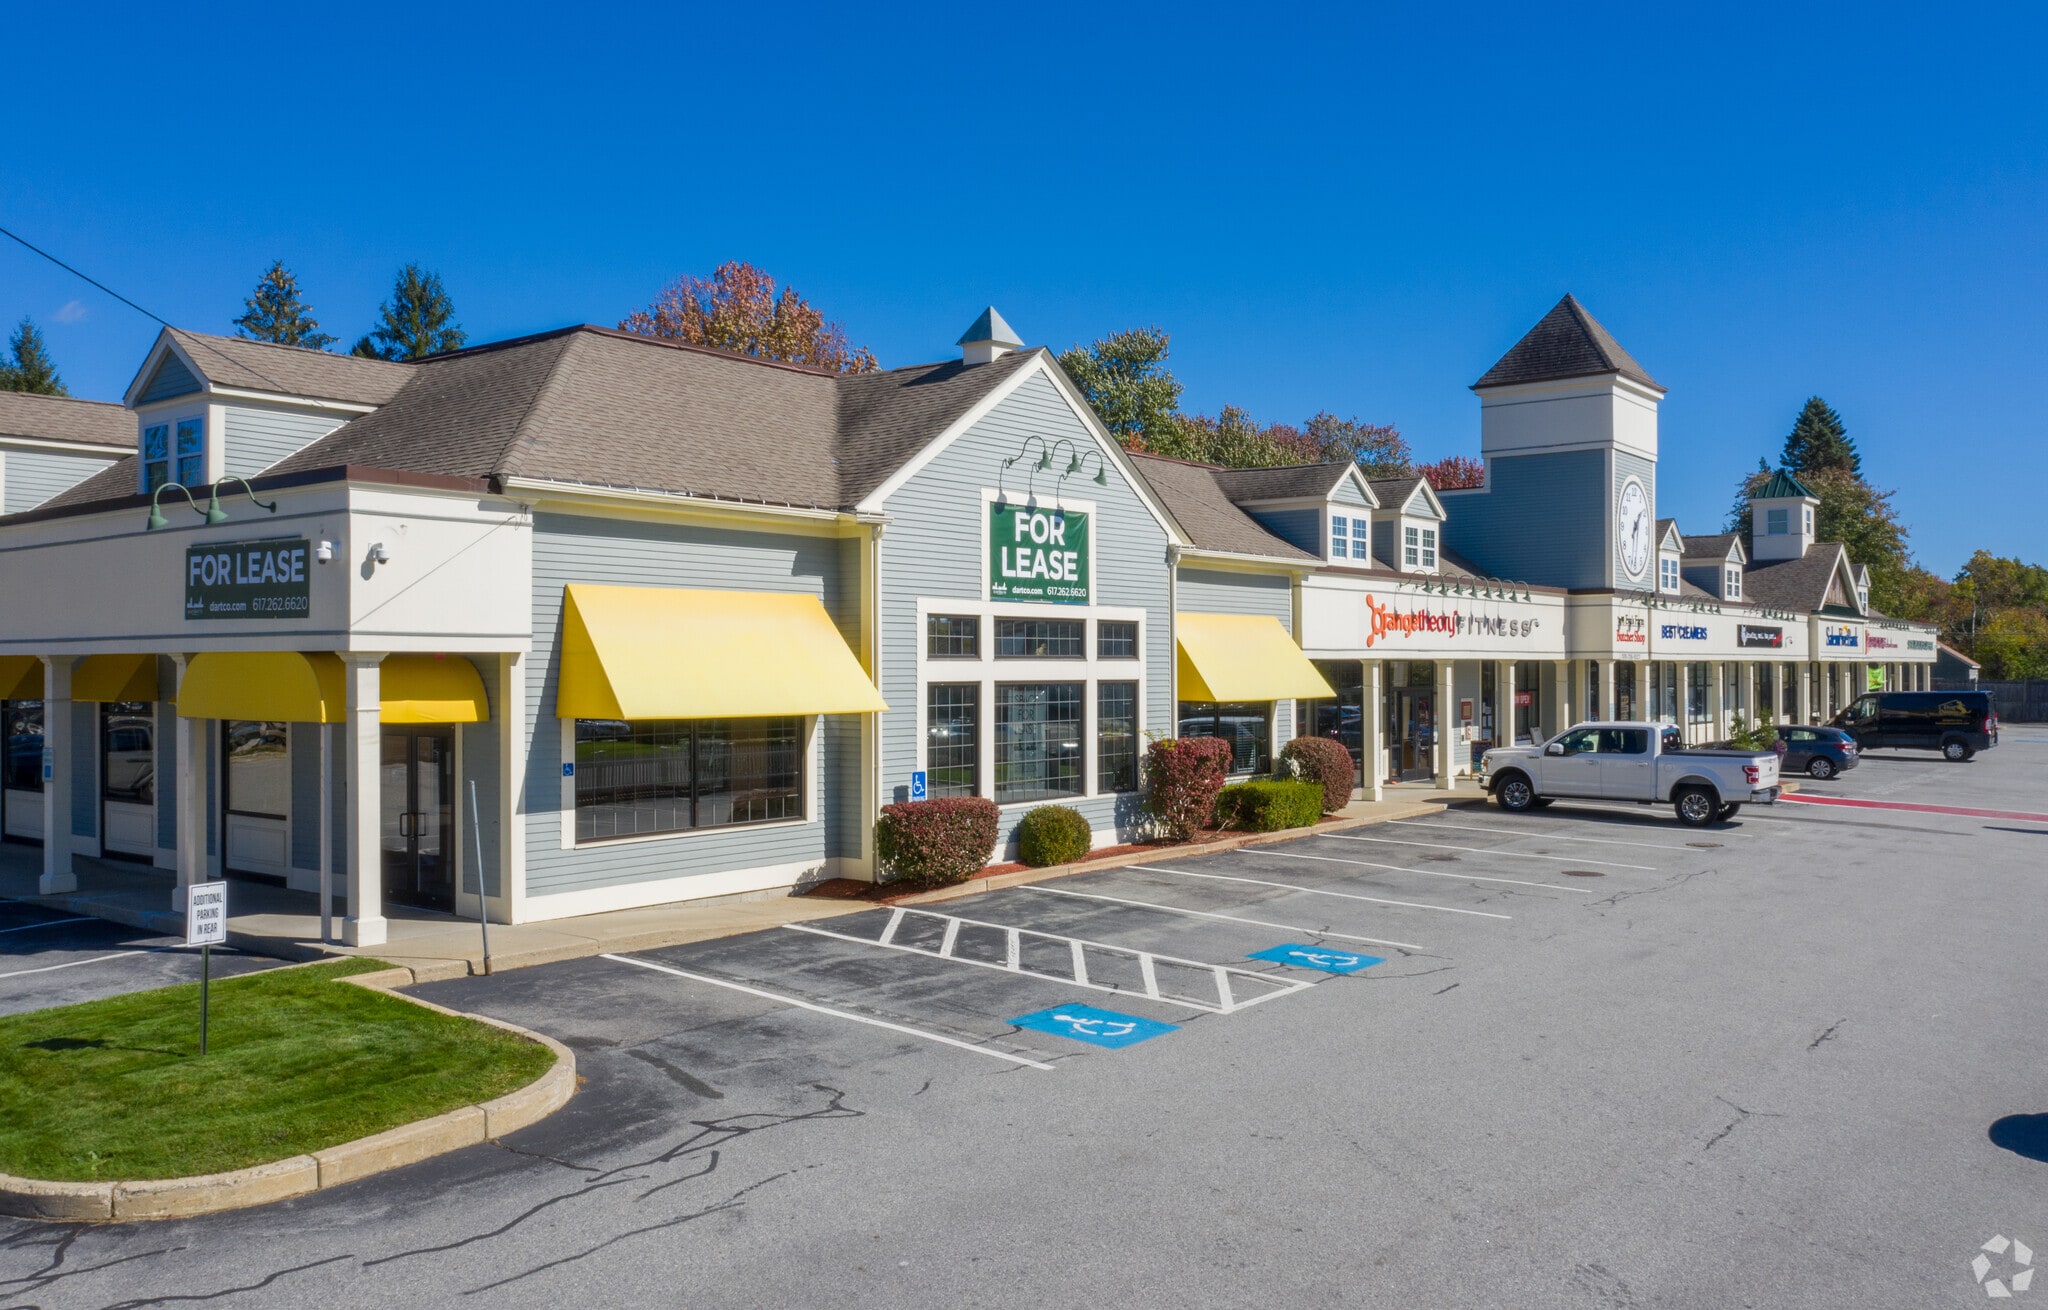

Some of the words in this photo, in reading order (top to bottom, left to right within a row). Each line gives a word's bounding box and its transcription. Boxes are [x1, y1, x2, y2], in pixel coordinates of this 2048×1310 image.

[1015, 511, 1066, 546] FOR
[190, 554, 231, 587] FOR
[236, 549, 305, 584] LEASE
[1001, 546, 1079, 582] LEASE
[1011, 586, 1044, 595] dartco.com
[1046, 586, 1087, 597] 617.262.6620
[209, 601, 247, 612] dartco.com
[252, 597, 308, 611] 617.262.6620
[1457, 616, 1533, 638] FITNESS
[1661, 625, 1677, 639] BEST
[1679, 626, 1707, 640] CLEANERS
[193, 892, 222, 906] ADDITIONAL
[197, 907, 219, 920] PARKING
[197, 924, 203, 935] IN
[204, 922, 218, 934] REAR
